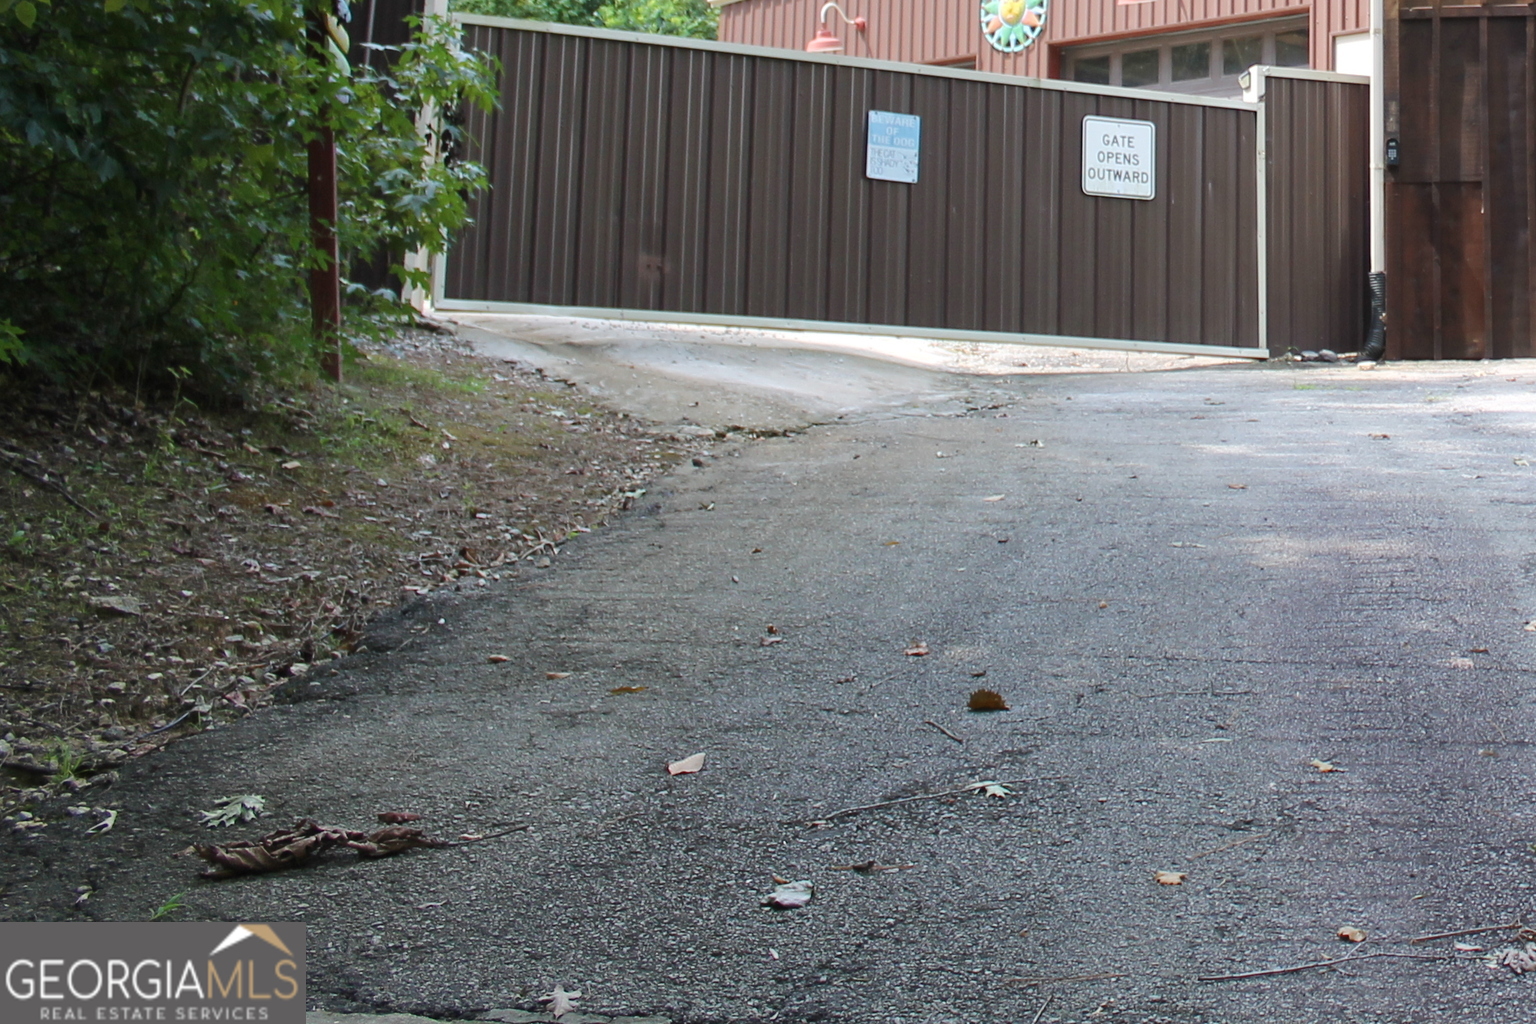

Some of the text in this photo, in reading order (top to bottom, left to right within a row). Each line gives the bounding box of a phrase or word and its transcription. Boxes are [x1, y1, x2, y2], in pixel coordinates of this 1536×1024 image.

[871, 114, 915, 128] BEWARE
[886, 126, 899, 136] OF
[872, 134, 915, 148] THE DOG
[1102, 134, 1135, 149] GATE
[871, 148, 896, 159] THE CAT
[1097, 150, 1140, 166] OPENS
[1087, 167, 1149, 184] OUTWARD
